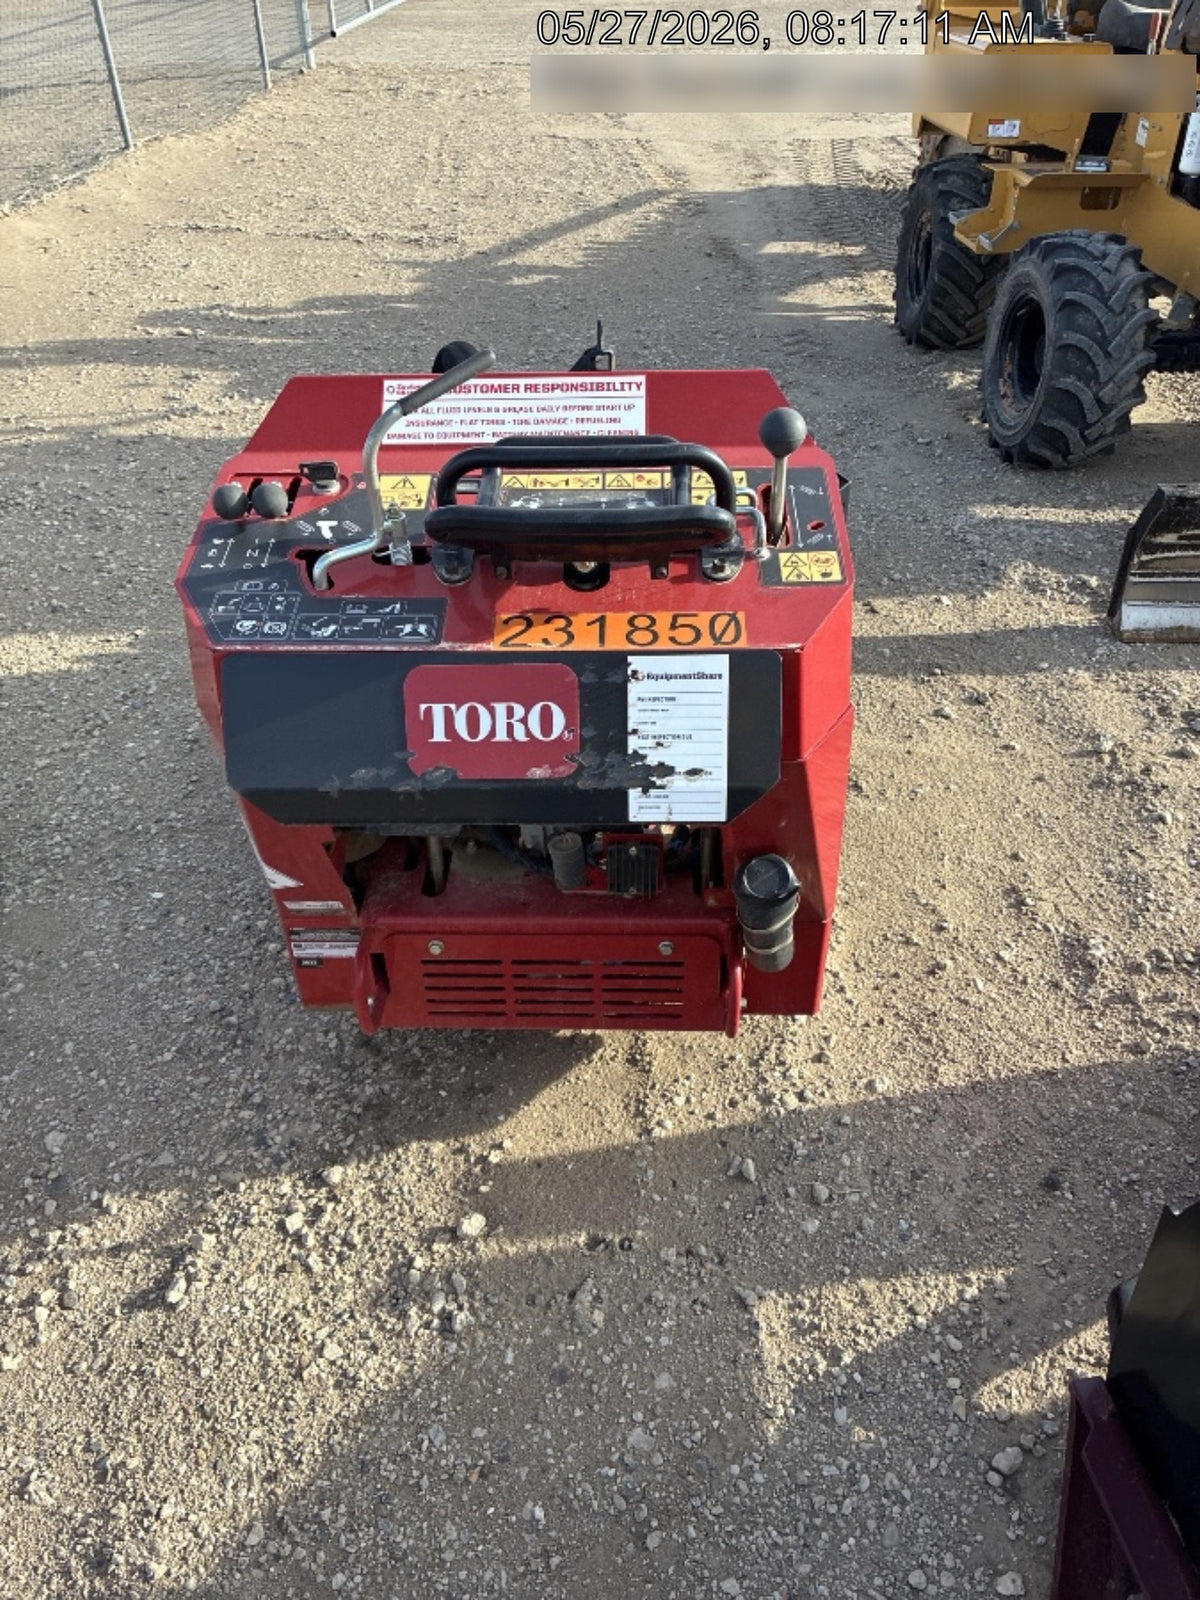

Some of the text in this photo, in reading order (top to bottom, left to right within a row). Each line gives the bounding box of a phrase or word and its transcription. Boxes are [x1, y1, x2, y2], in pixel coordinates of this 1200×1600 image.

[447, 381, 643, 394] USTOMER RESPONSIBILITY
[499, 611, 743, 648] 231850
[646, 672, 723, 682] EquipmentShare
[419, 701, 566, 742] TORO
